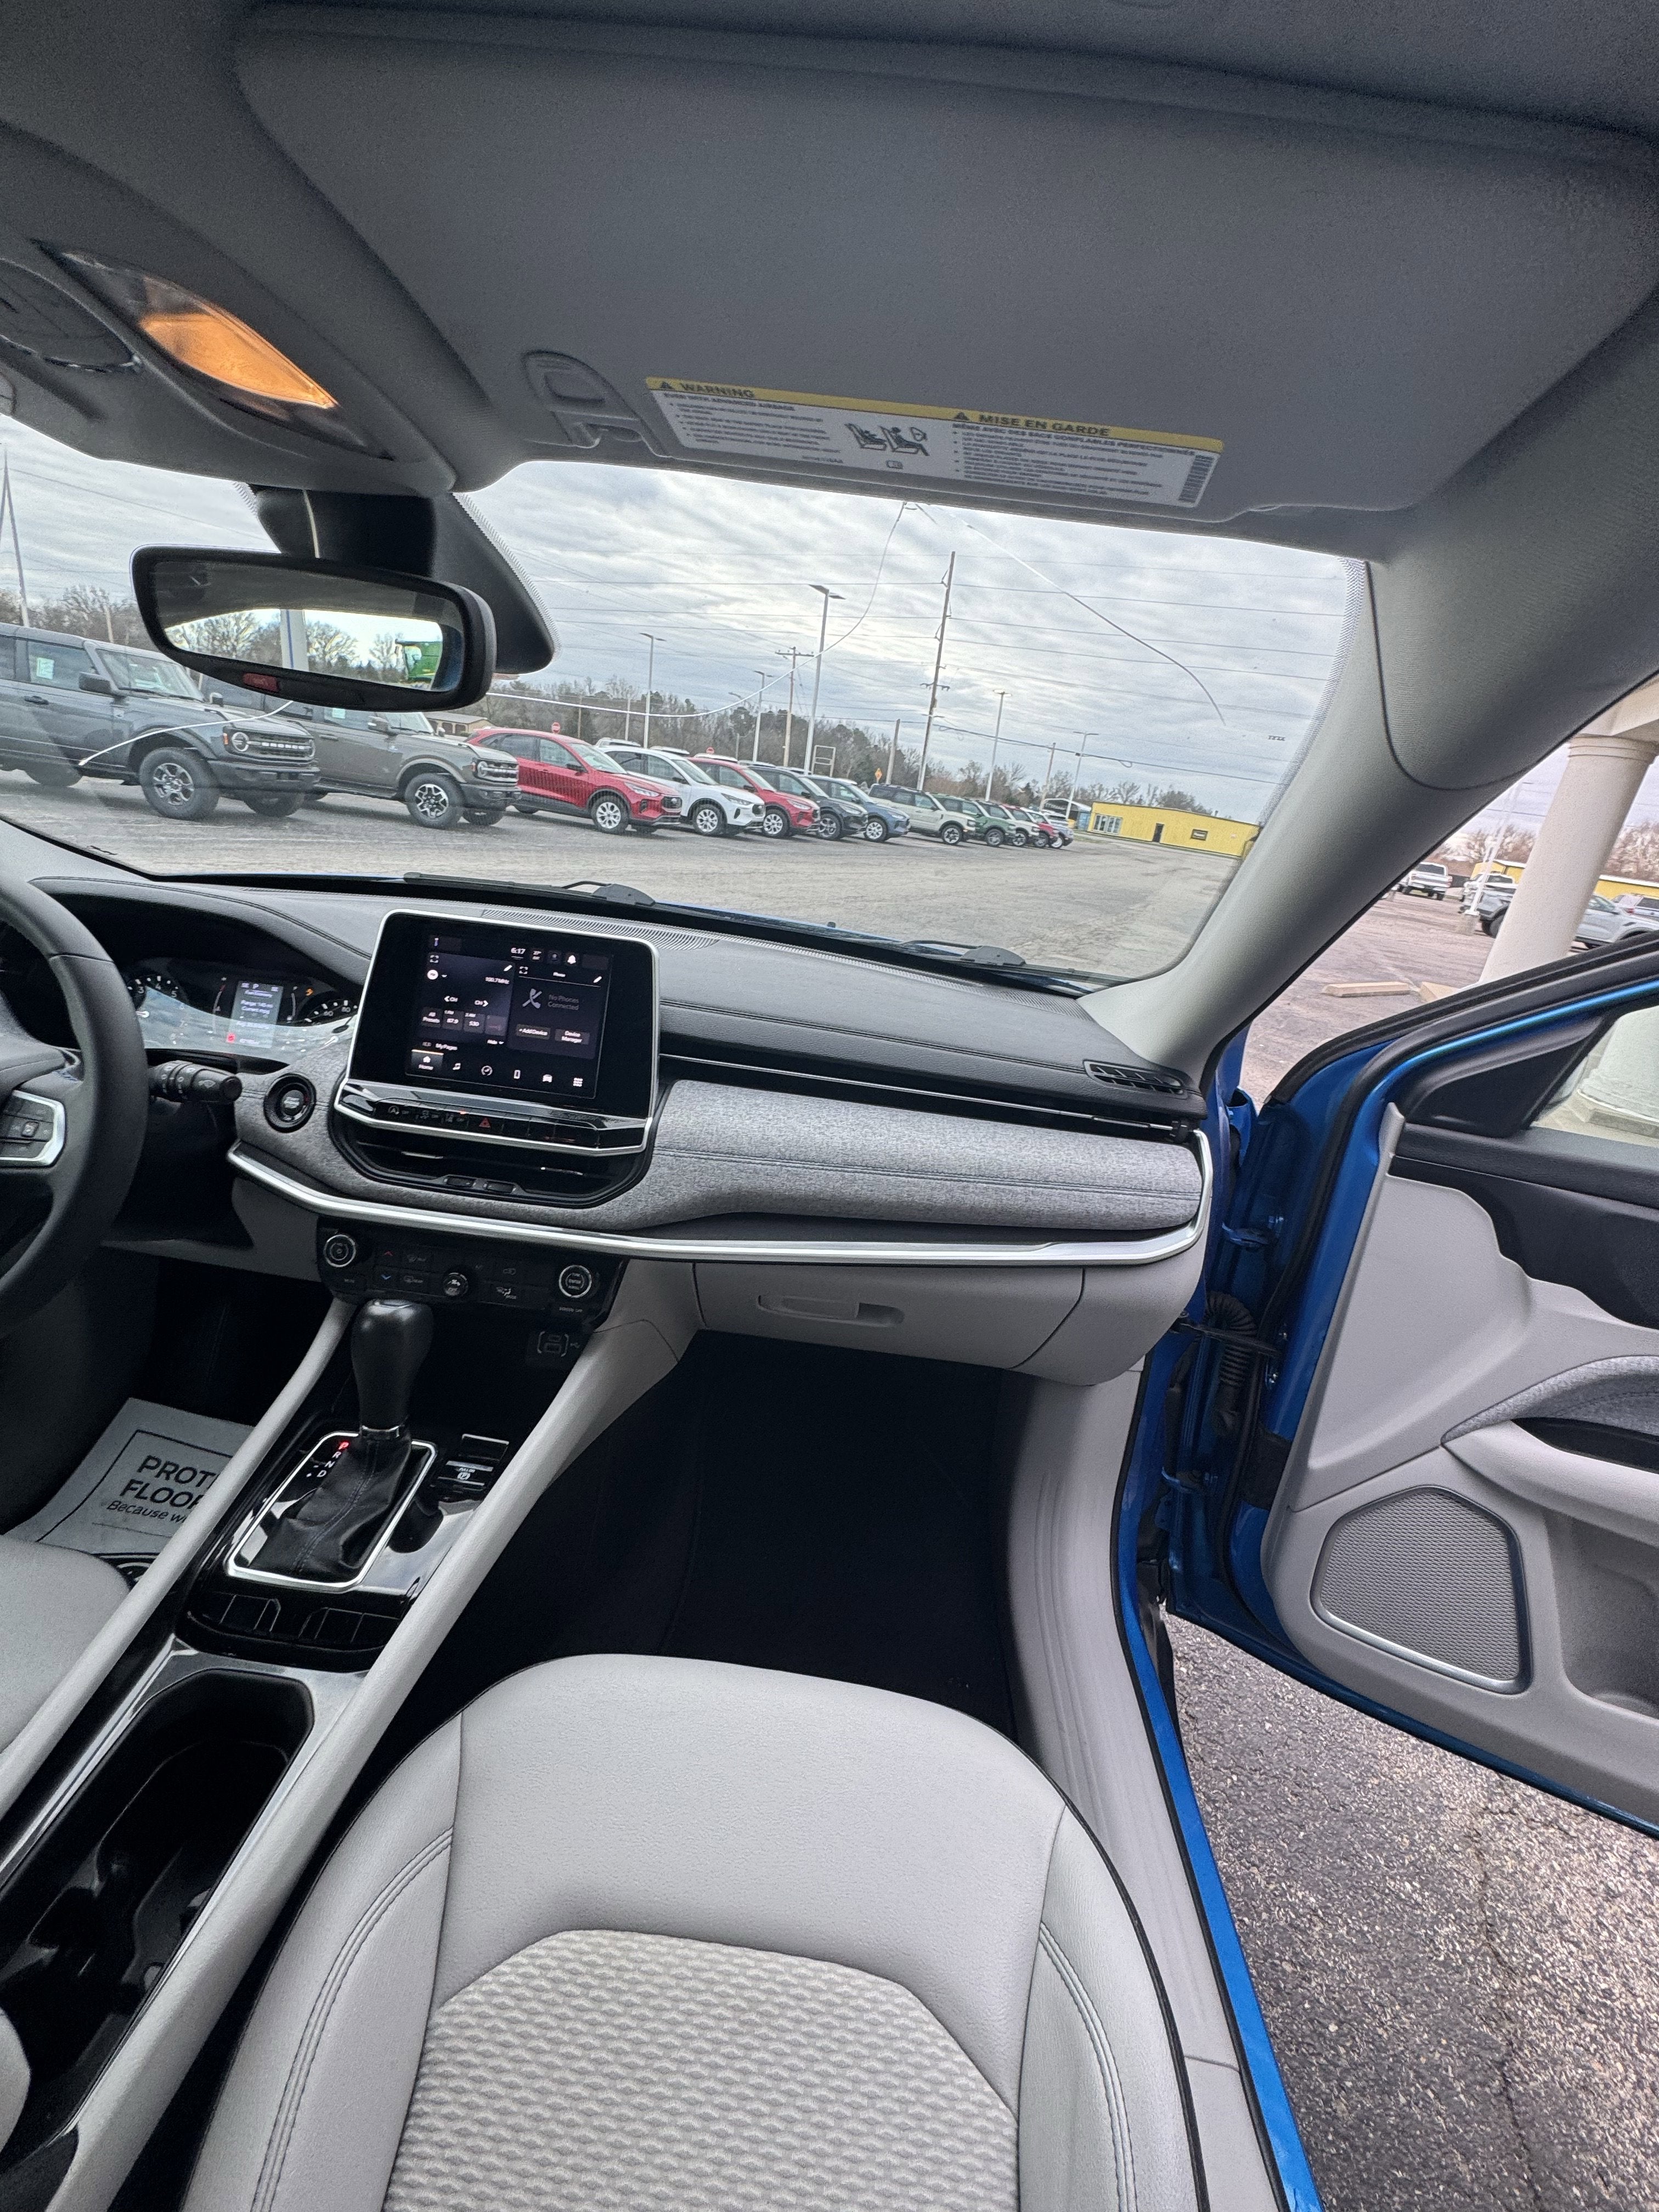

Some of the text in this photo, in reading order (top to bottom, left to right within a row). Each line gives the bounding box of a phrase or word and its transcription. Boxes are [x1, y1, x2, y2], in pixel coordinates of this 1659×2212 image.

[680, 382, 755, 399] WARNING
[979, 414, 1110, 436] MISE EN GARDE
[138, 986, 145, 994] 3
[338, 1441, 349, 1450] P
[332, 1451, 342, 1459] R
[106, 1500, 169, 1520] Because
